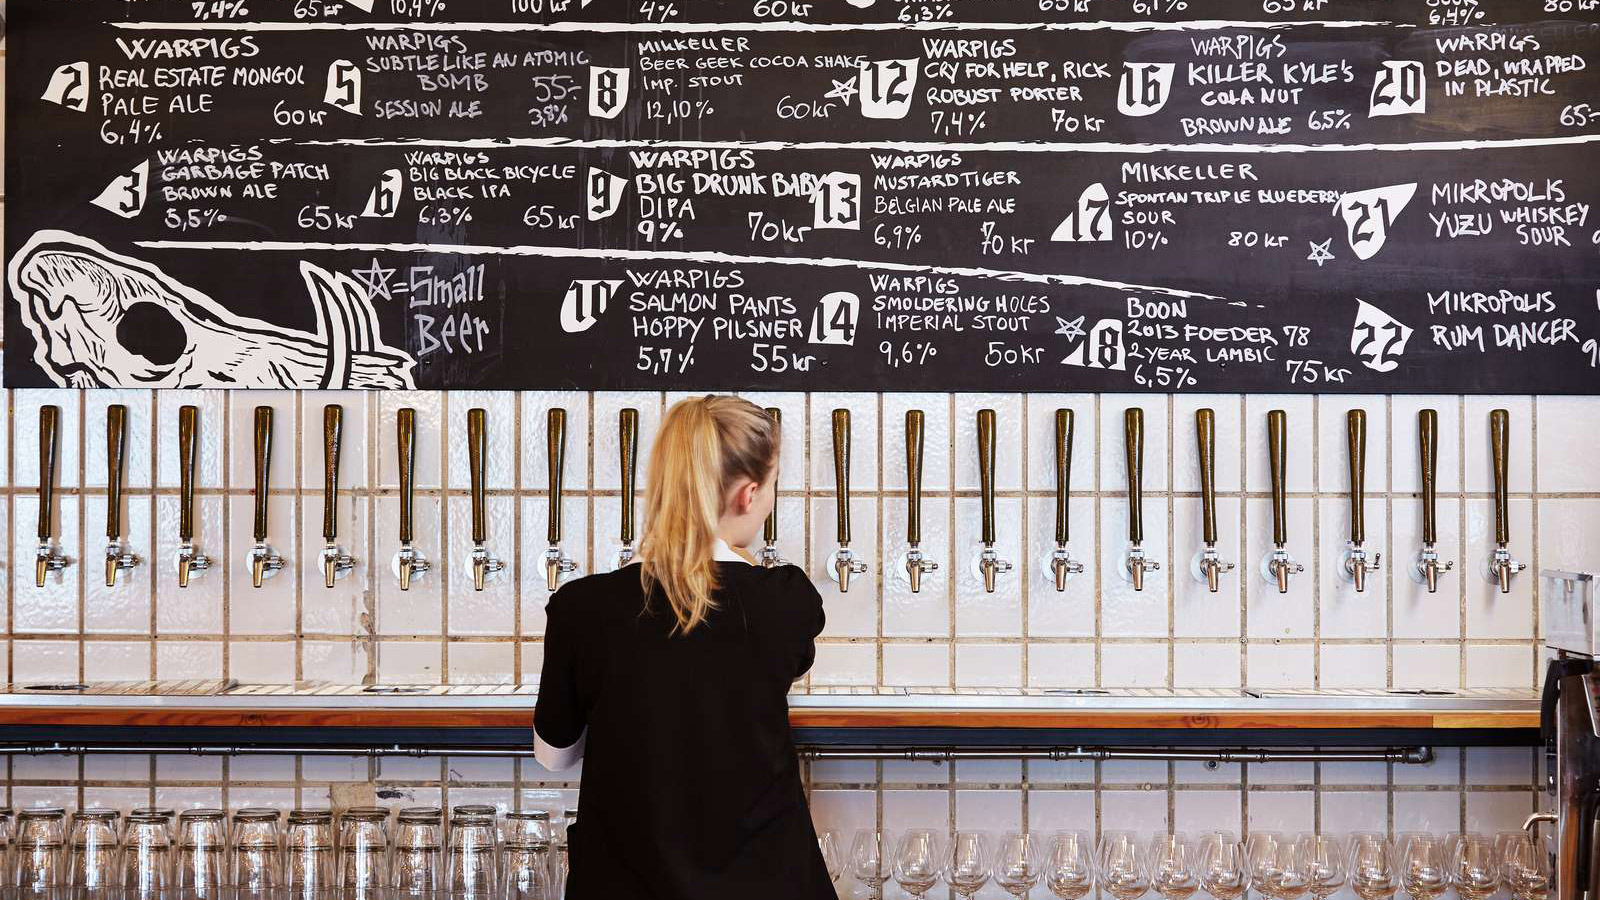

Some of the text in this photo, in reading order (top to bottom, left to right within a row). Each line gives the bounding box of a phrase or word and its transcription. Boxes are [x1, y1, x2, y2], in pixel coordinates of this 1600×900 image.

[191, 0, 249, 21] 7,4%
[293, 0, 322, 19] 65
[390, 0, 446, 18] 10,4%
[639, 0, 678, 23] 4%
[753, 0, 788, 17] 60
[897, 3, 954, 22] 6,3%
[1428, 6, 1486, 26] 6,4%
[115, 35, 260, 60] WARPIGS
[365, 32, 467, 54] WARPIGS
[638, 36, 751, 56] MIKKELLER
[921, 37, 1017, 60] WARPIGS
[1190, 33, 1287, 60] WARPIGS
[1435, 32, 1541, 54] WARPIGS
[366, 49, 589, 73] SUBTLE LIKE AN ATOMIC
[639, 55, 867, 72] BEER GEEK COCOA SHAKE
[924, 60, 960, 85] CRY
[965, 62, 1001, 79] FOR
[1063, 60, 1112, 79] RICK
[1435, 54, 1586, 80] DEAD, WRAPPED
[98, 64, 305, 91] REAL ESTATE MONGOL
[416, 73, 489, 92] BOMB
[688, 74, 743, 88] STOUT
[862, 61, 911, 104] 12
[1188, 61, 1274, 86] KILLER
[1373, 62, 1423, 107] 20
[926, 85, 1083, 107] ROBUST PORTER
[1200, 87, 1304, 107] COLA NUT
[1444, 77, 1556, 98] IN PLASTIC
[101, 92, 213, 116] PALE ALE
[374, 98, 441, 120] SESSION
[448, 100, 483, 118] ALE
[646, 99, 714, 125] 12,10%
[100, 118, 162, 145] 6,4%
[930, 110, 986, 137] 7,4%
[1051, 107, 1080, 133] 70
[1179, 116, 1292, 138] BROWN ALE
[157, 145, 263, 166] WARPIGS
[404, 150, 490, 167] WARPIGS
[628, 148, 756, 171] WARPIGS
[870, 152, 962, 170] WARPIGS
[161, 161, 330, 182] GARBAGE PATCH
[409, 164, 576, 184] BIG BLACK BICYCLE
[1121, 161, 1259, 184] MIKKELLER
[161, 183, 278, 202] BROWN ALE
[413, 183, 511, 201] BLACK IPA
[635, 172, 827, 204] BIG DRUNK BABY
[1431, 178, 1566, 207] MIKROPOLIS
[640, 195, 696, 220] DIPA
[818, 180, 858, 224] 13
[874, 195, 1016, 215] BELGIAN PALE ALE
[1114, 189, 1348, 217] SPONTAN TRIPLE BLUEBERRY
[418, 205, 473, 226] 6,3%
[1121, 210, 1176, 225] SOUR
[1428, 202, 1590, 238] YUZU WHISKEY
[637, 219, 684, 243] 9%
[874, 223, 922, 251] 6,9%
[1125, 230, 1169, 251] 10%
[1227, 231, 1259, 247] 80
[1515, 223, 1572, 247] SOUR
[625, 269, 745, 290] WARPIGS
[868, 273, 960, 295] WARPIGS
[629, 291, 797, 318] SALMON PANTS
[871, 294, 1051, 314] SMOLDERING HOLES
[1126, 296, 1187, 320] BOON
[1426, 289, 1556, 315] MIKROPOLIS
[632, 315, 804, 344] HOPPY PILSNER
[817, 300, 854, 342] 14
[877, 312, 1031, 333] IMPERIAL STOUT
[414, 312, 490, 357] Beer
[1127, 319, 1311, 348] 2013 FOEDER 78
[1355, 321, 1403, 364] 22
[1429, 318, 1580, 353] RUM DANCER
[636, 344, 695, 375] 5,7%
[750, 342, 788, 373] 55
[879, 340, 937, 368] 9,6%
[1127, 342, 1276, 364] 2 YEAR LAMBIC
[1134, 363, 1198, 389] 6,5%
